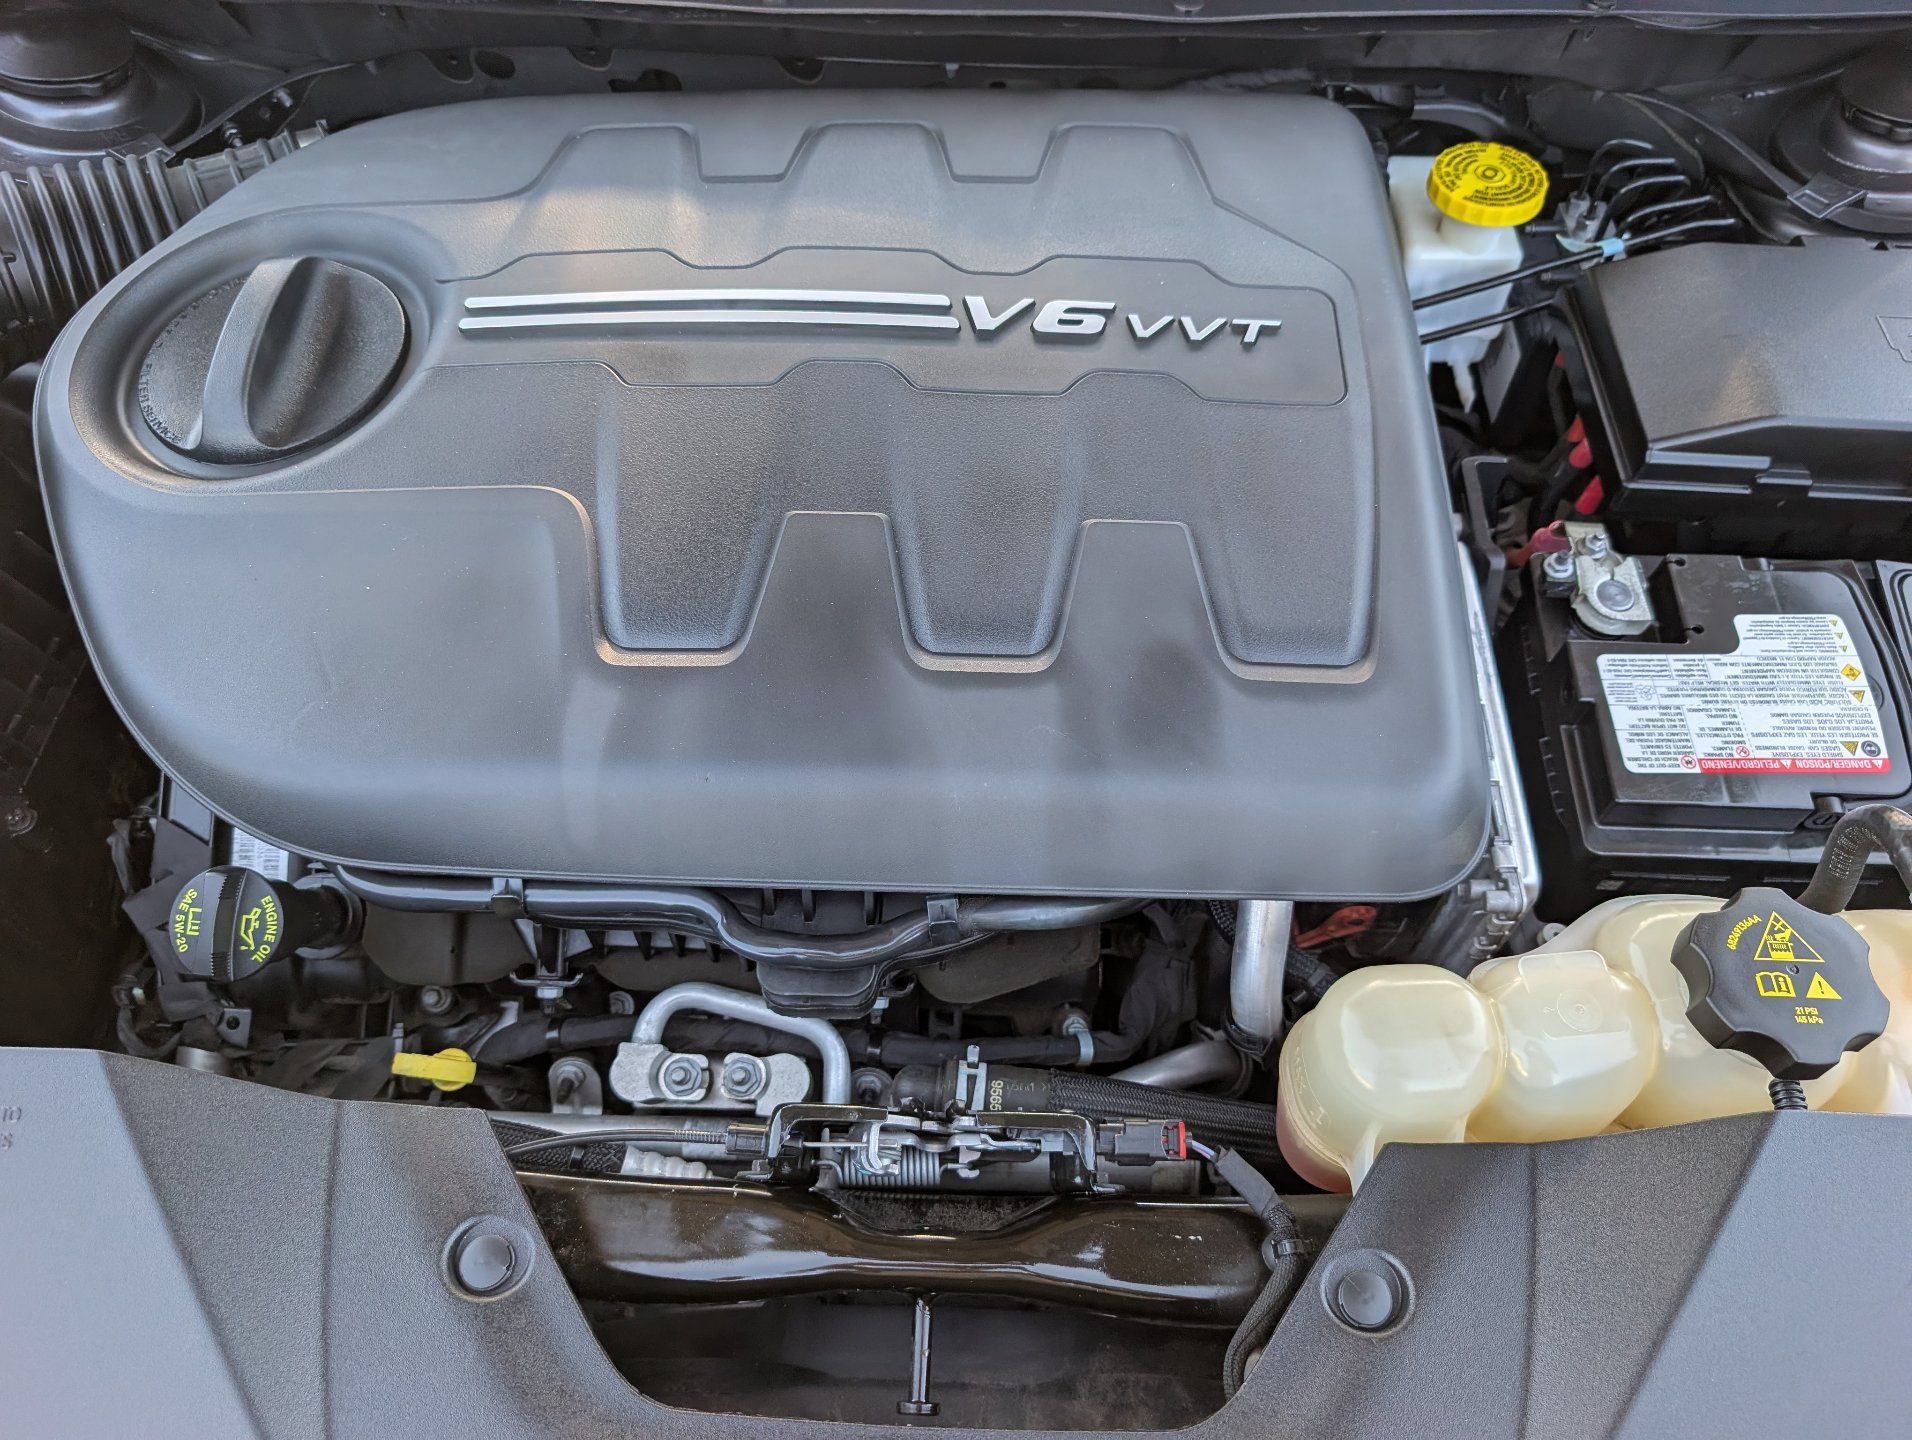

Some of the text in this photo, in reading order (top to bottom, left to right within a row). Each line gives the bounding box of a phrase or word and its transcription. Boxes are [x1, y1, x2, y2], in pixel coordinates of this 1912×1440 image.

[963, 295, 1282, 347] V6 VVT
[1703, 759, 1780, 769] PELIGRO/VENENO
[1796, 760, 1872, 768] DANGER/POISON
[174, 888, 198, 953] SAE 5W-20
[260, 894, 279, 943] ENGINE
[250, 945, 271, 963] OIL
[1795, 1006, 1818, 1015] 21 PSI
[1795, 1015, 1824, 1024] 145 kPa
[990, 1080, 1004, 1111] 9565
